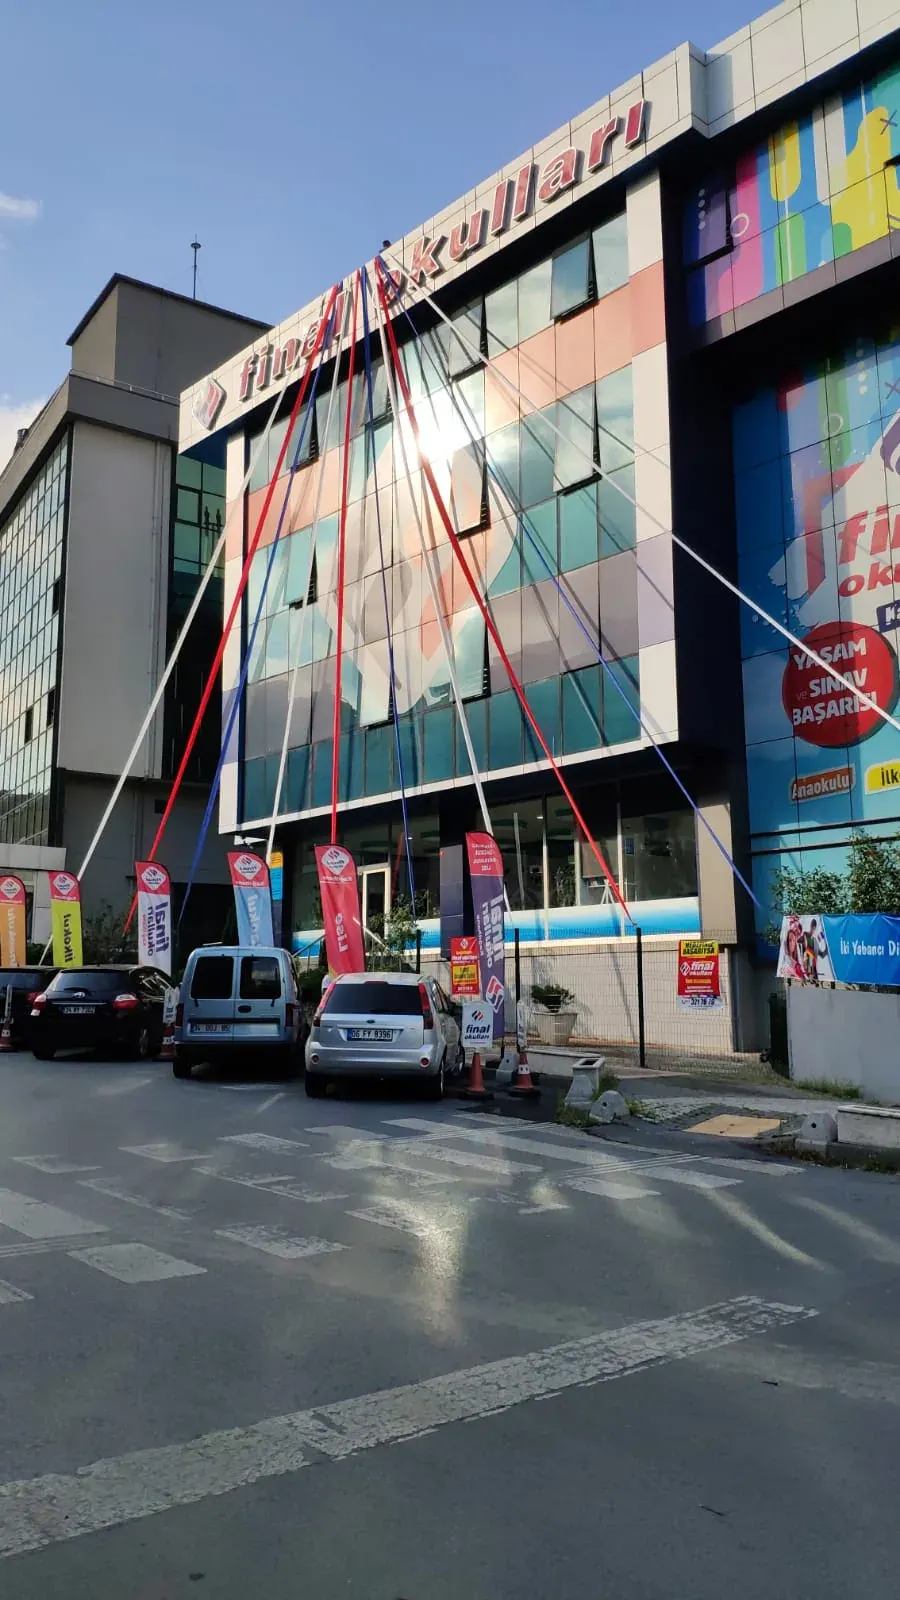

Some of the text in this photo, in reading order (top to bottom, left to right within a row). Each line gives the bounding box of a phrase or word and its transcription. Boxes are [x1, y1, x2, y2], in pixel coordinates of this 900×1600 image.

[238, 97, 645, 402] final okulları
[809, 667, 868, 698] SINAV
[792, 773, 850, 800] Anaokulu
[840, 937, 849, 955] İki
[852, 940, 884, 956] Yabancı
[466, 1024, 490, 1033] final
